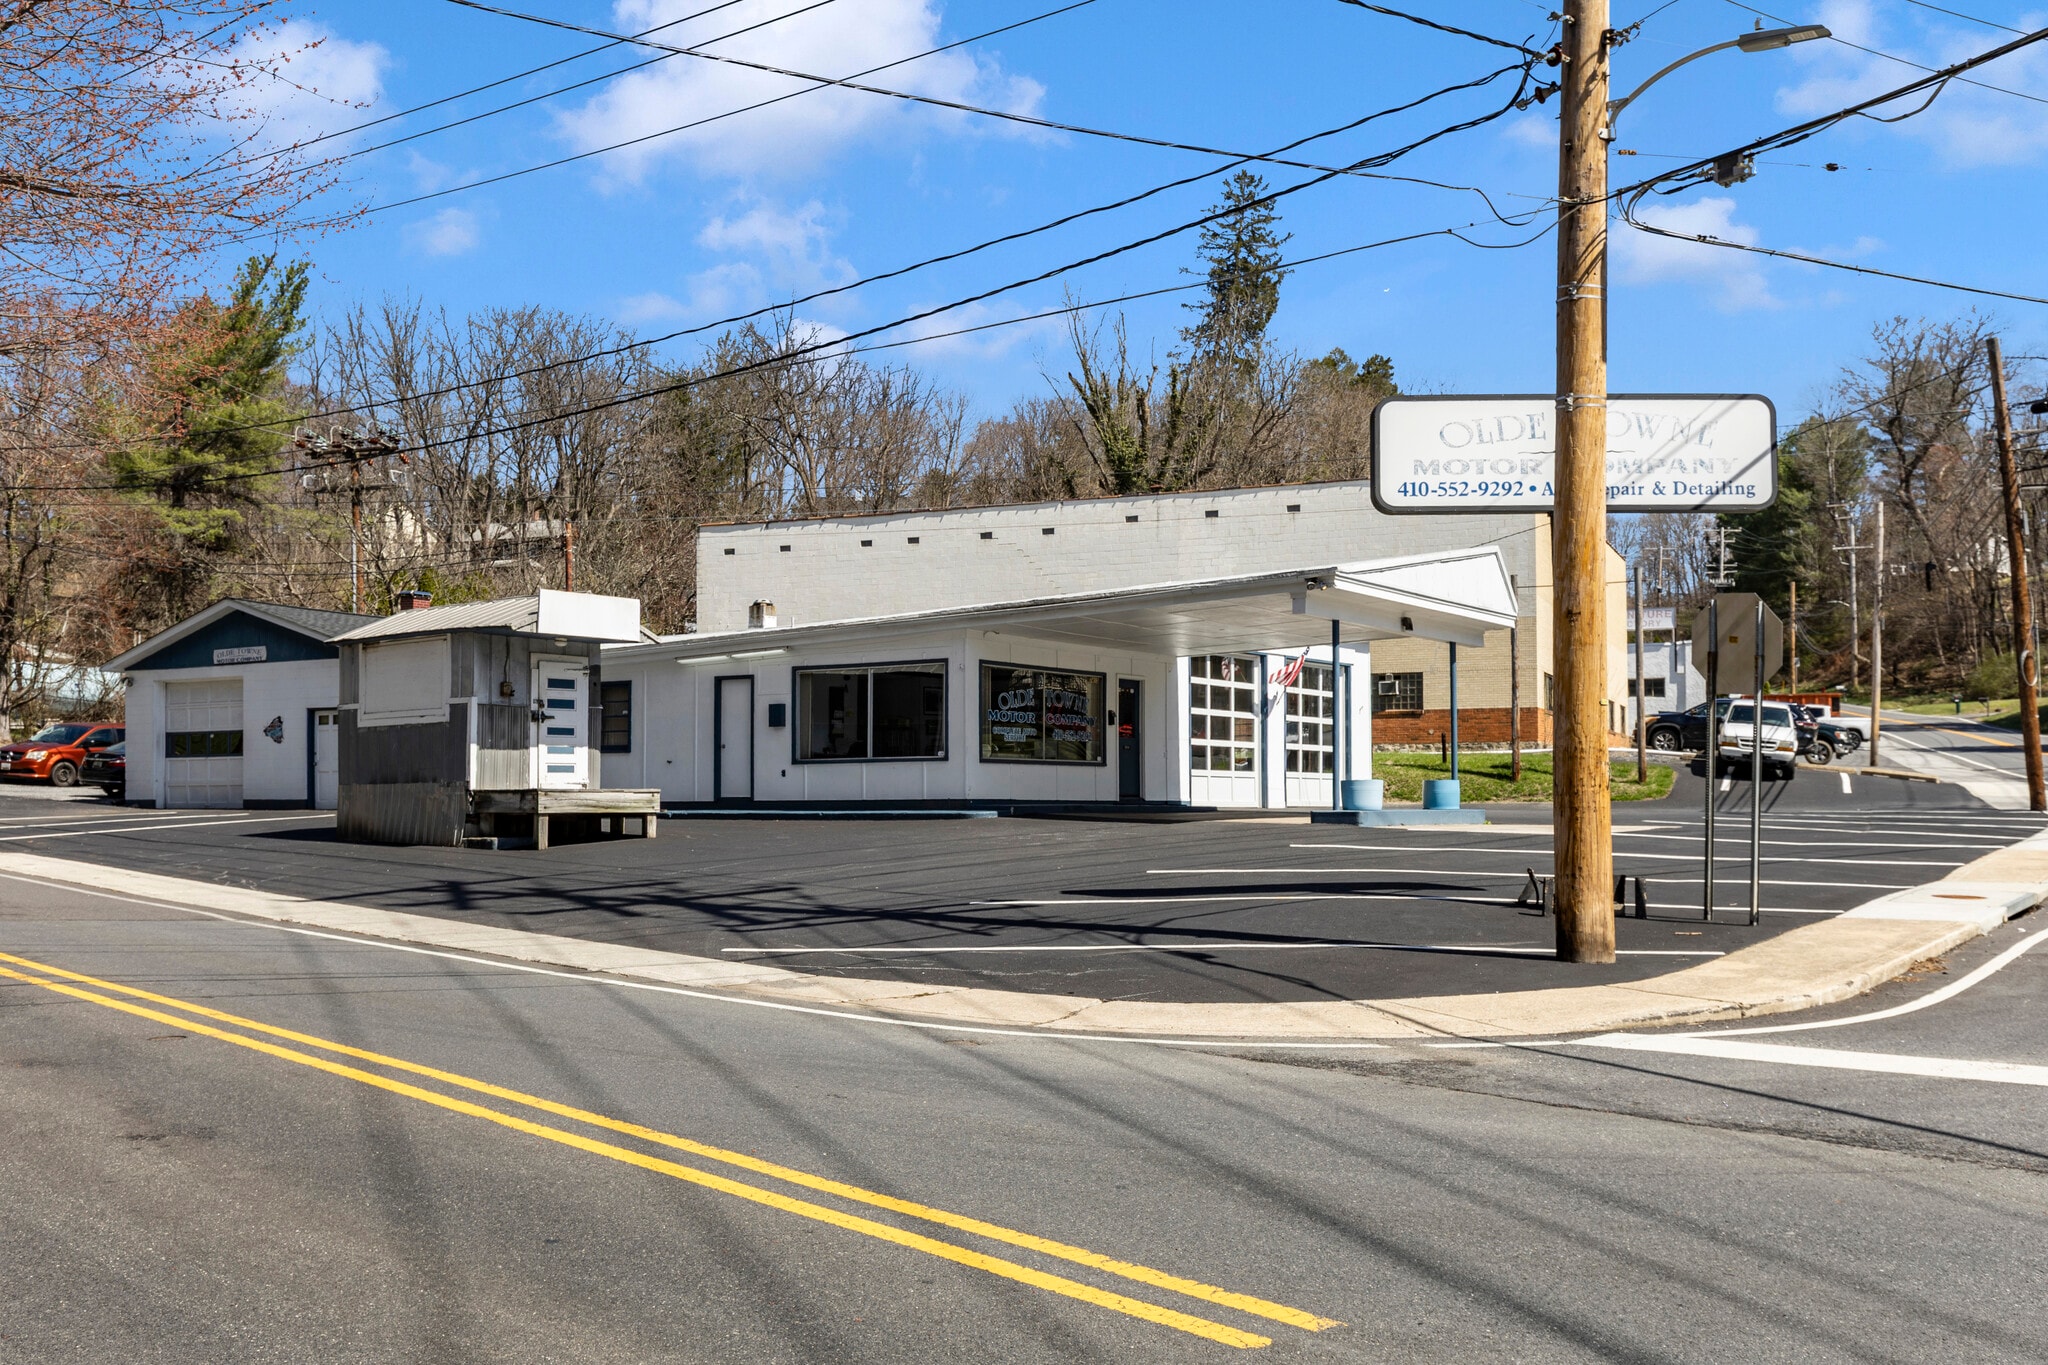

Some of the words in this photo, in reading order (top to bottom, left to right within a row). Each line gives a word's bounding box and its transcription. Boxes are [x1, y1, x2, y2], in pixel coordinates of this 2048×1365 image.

[1439, 412, 1547, 449] OLDE
[1606, 410, 1719, 449] OWNE
[1413, 458, 1544, 476] MOTOR
[1397, 481, 1524, 497] 410-552-9292
[1652, 481, 1667, 496] &
[1672, 480, 1756, 498] Detailing
[997, 687, 1035, 711] OLDE
[1045, 688, 1090, 715] TOWNE
[987, 708, 1036, 724] MOTOR
[1045, 712, 1097, 727] COMPANY
